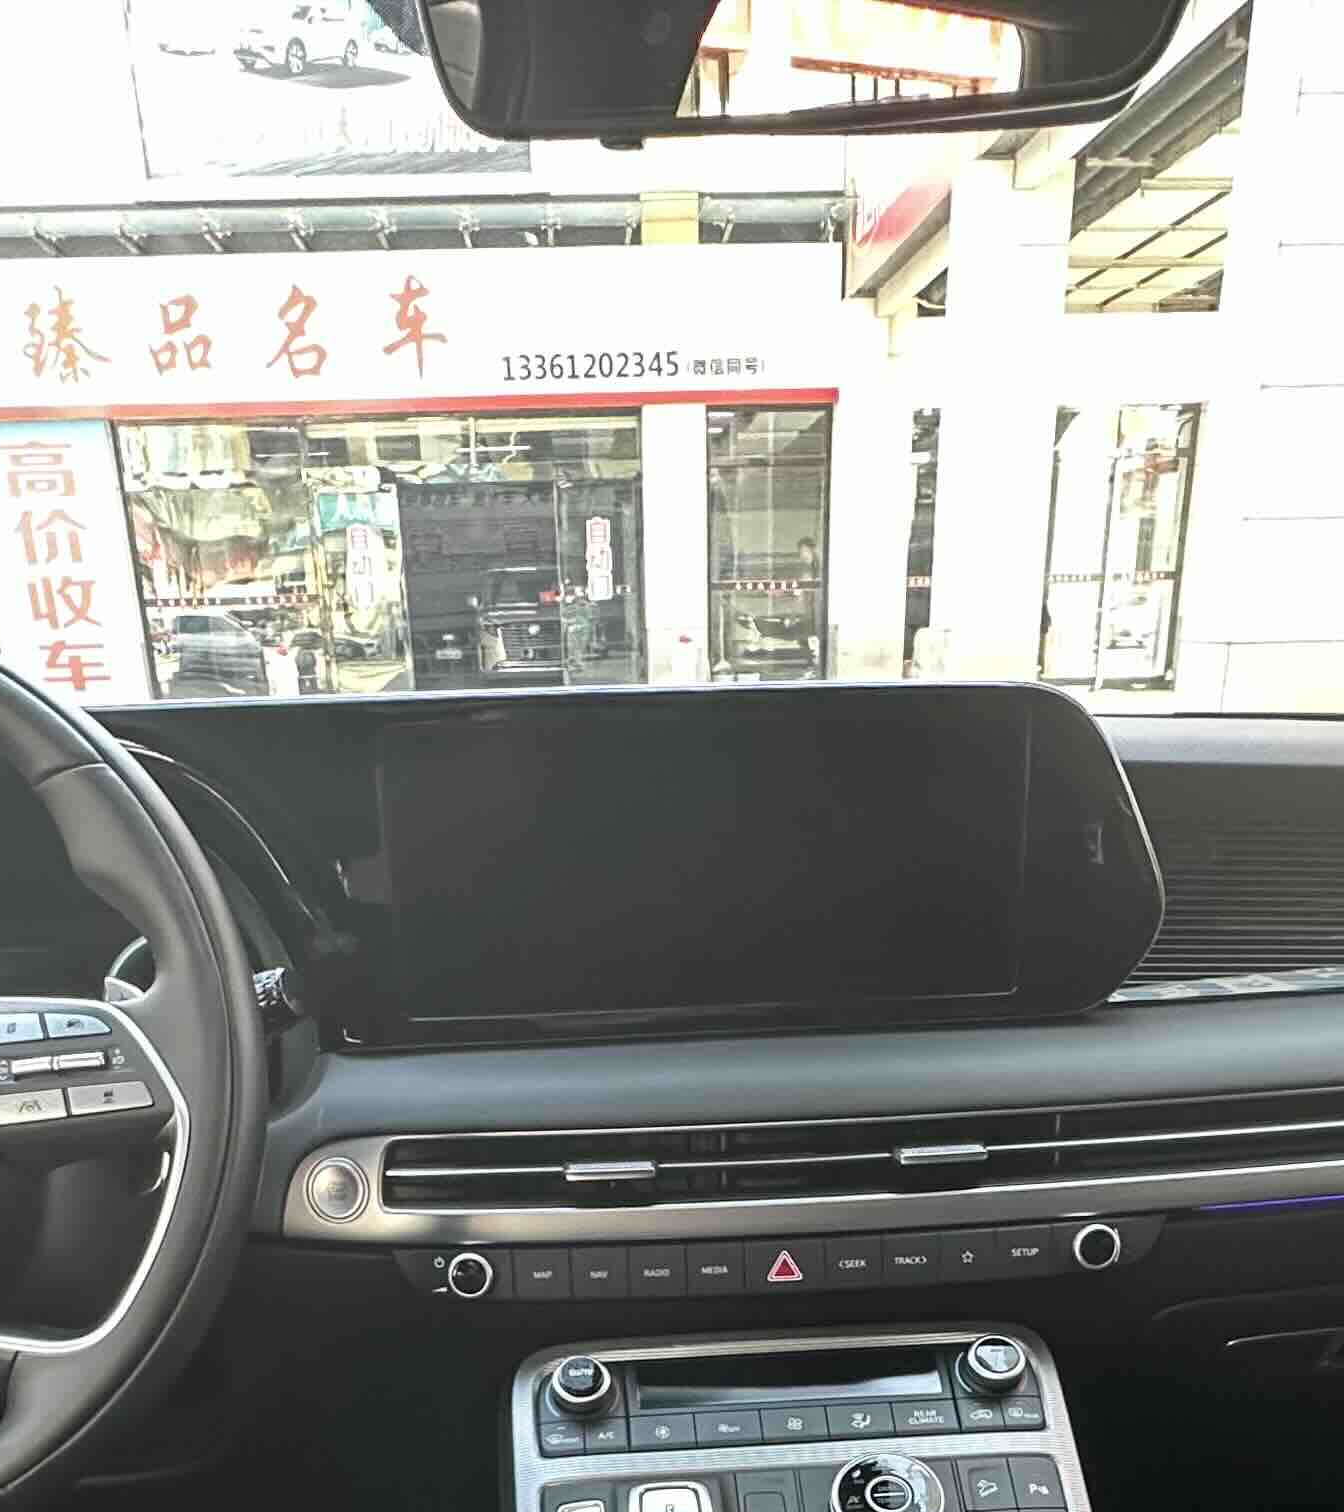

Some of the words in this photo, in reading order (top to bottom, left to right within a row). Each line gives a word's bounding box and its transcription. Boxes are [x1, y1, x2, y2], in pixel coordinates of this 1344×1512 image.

[501, 350, 679, 381] 13361202345
[0, 441, 112, 692] 高价收车
[1010, 1247, 1040, 1257] SETUP
